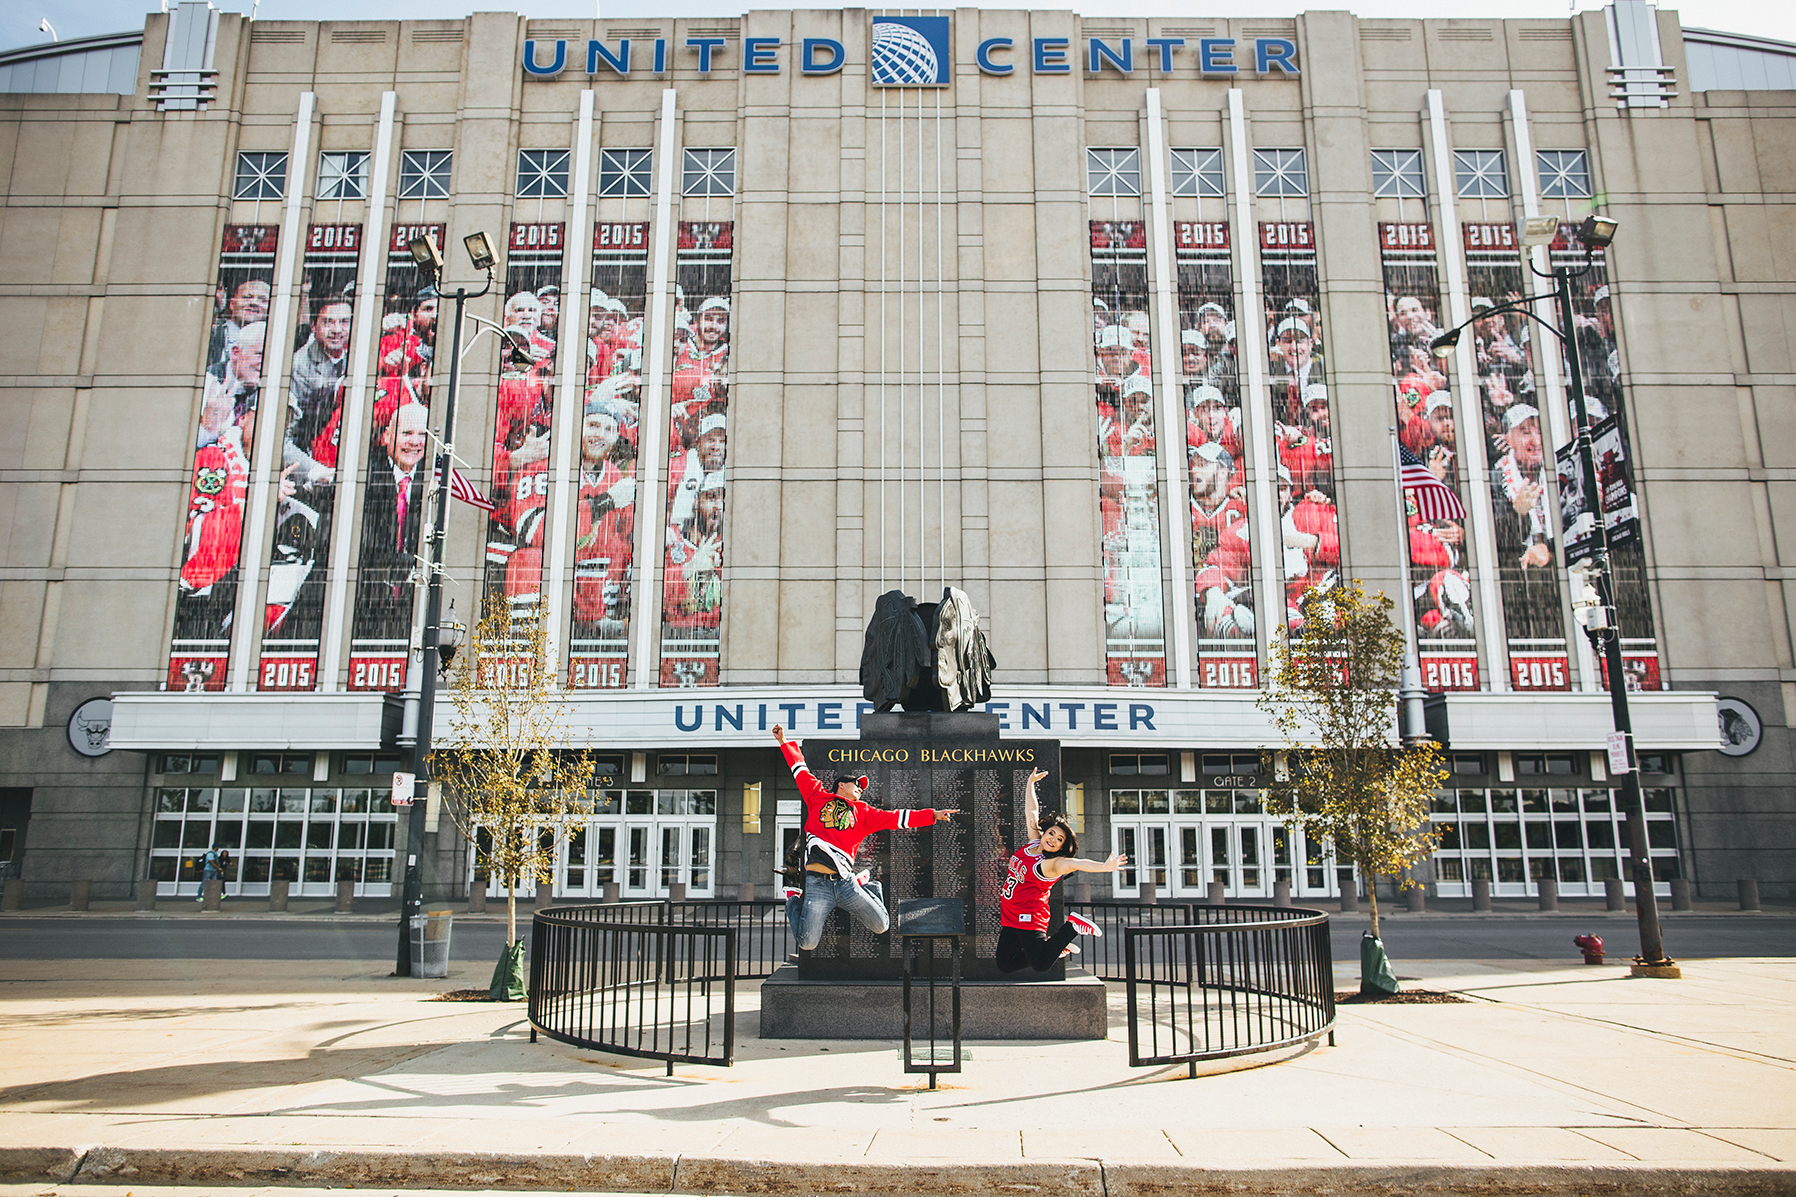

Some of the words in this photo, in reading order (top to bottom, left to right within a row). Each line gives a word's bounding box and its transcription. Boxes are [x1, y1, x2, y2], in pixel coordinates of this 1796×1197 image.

[522, 38, 846, 75] UNITED
[976, 38, 1300, 75] CENTER
[312, 227, 355, 247] 2015
[516, 225, 558, 245] 2015
[600, 225, 643, 245] 2015
[1181, 223, 1224, 244] 2015
[1265, 224, 1308, 244] 2015
[1386, 225, 1429, 246] 2015
[1469, 225, 1512, 246] 2015
[265, 663, 310, 687] 2015
[355, 663, 400, 687] 2015
[575, 663, 620, 687] 2015
[1206, 663, 1251, 687] 2015
[1427, 663, 1474, 687] 2015
[1517, 663, 1565, 687] 2015
[985, 703, 1157, 731] ENTER
[828, 748, 909, 762] CHICAGO
[921, 748, 1035, 762] BLACKHAWKS
[1213, 776, 1244, 787] GATE
[1249, 776, 1256, 787] 2
